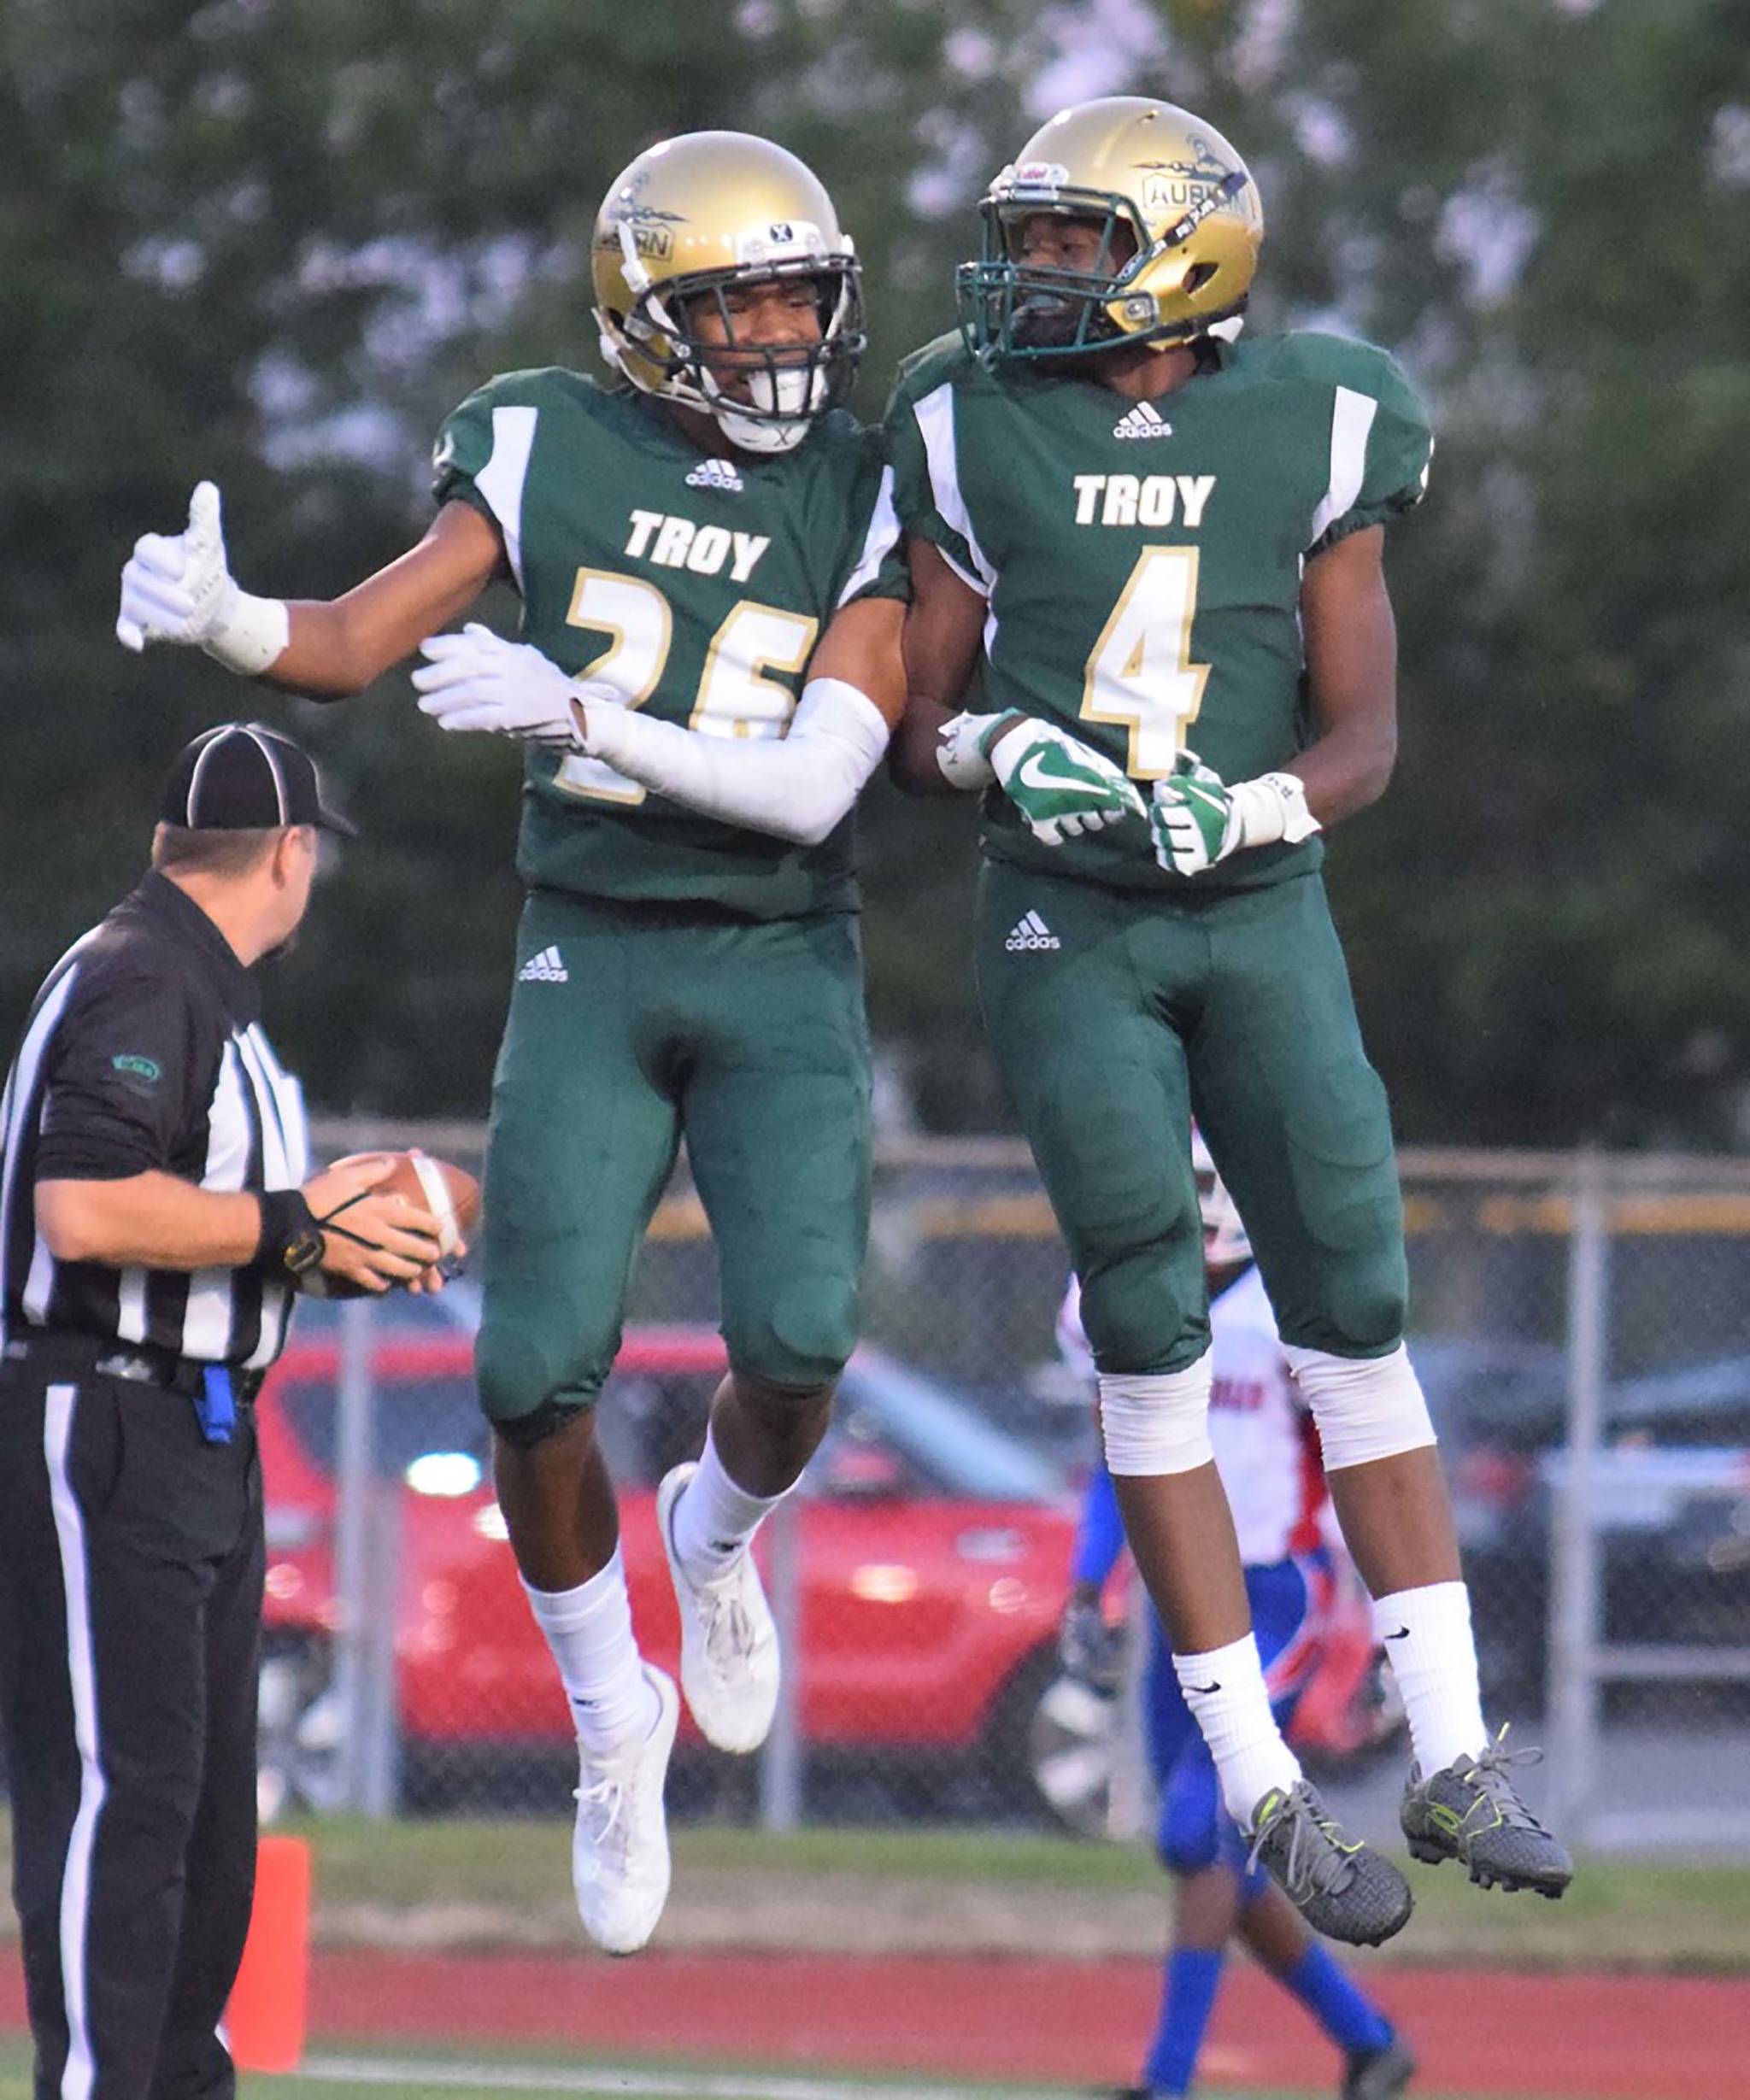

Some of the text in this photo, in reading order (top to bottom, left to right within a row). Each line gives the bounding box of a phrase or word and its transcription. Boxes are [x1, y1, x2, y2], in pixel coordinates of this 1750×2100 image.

[1113, 423, 1172, 438] adidas
[685, 472, 744, 492] adidas
[1073, 474, 1215, 526] TROY
[625, 509, 770, 583] TROY
[1079, 545, 1212, 780] 4
[552, 567, 820, 806] 26
[1006, 935, 1060, 951] adidas
[519, 967, 568, 982] adidas
